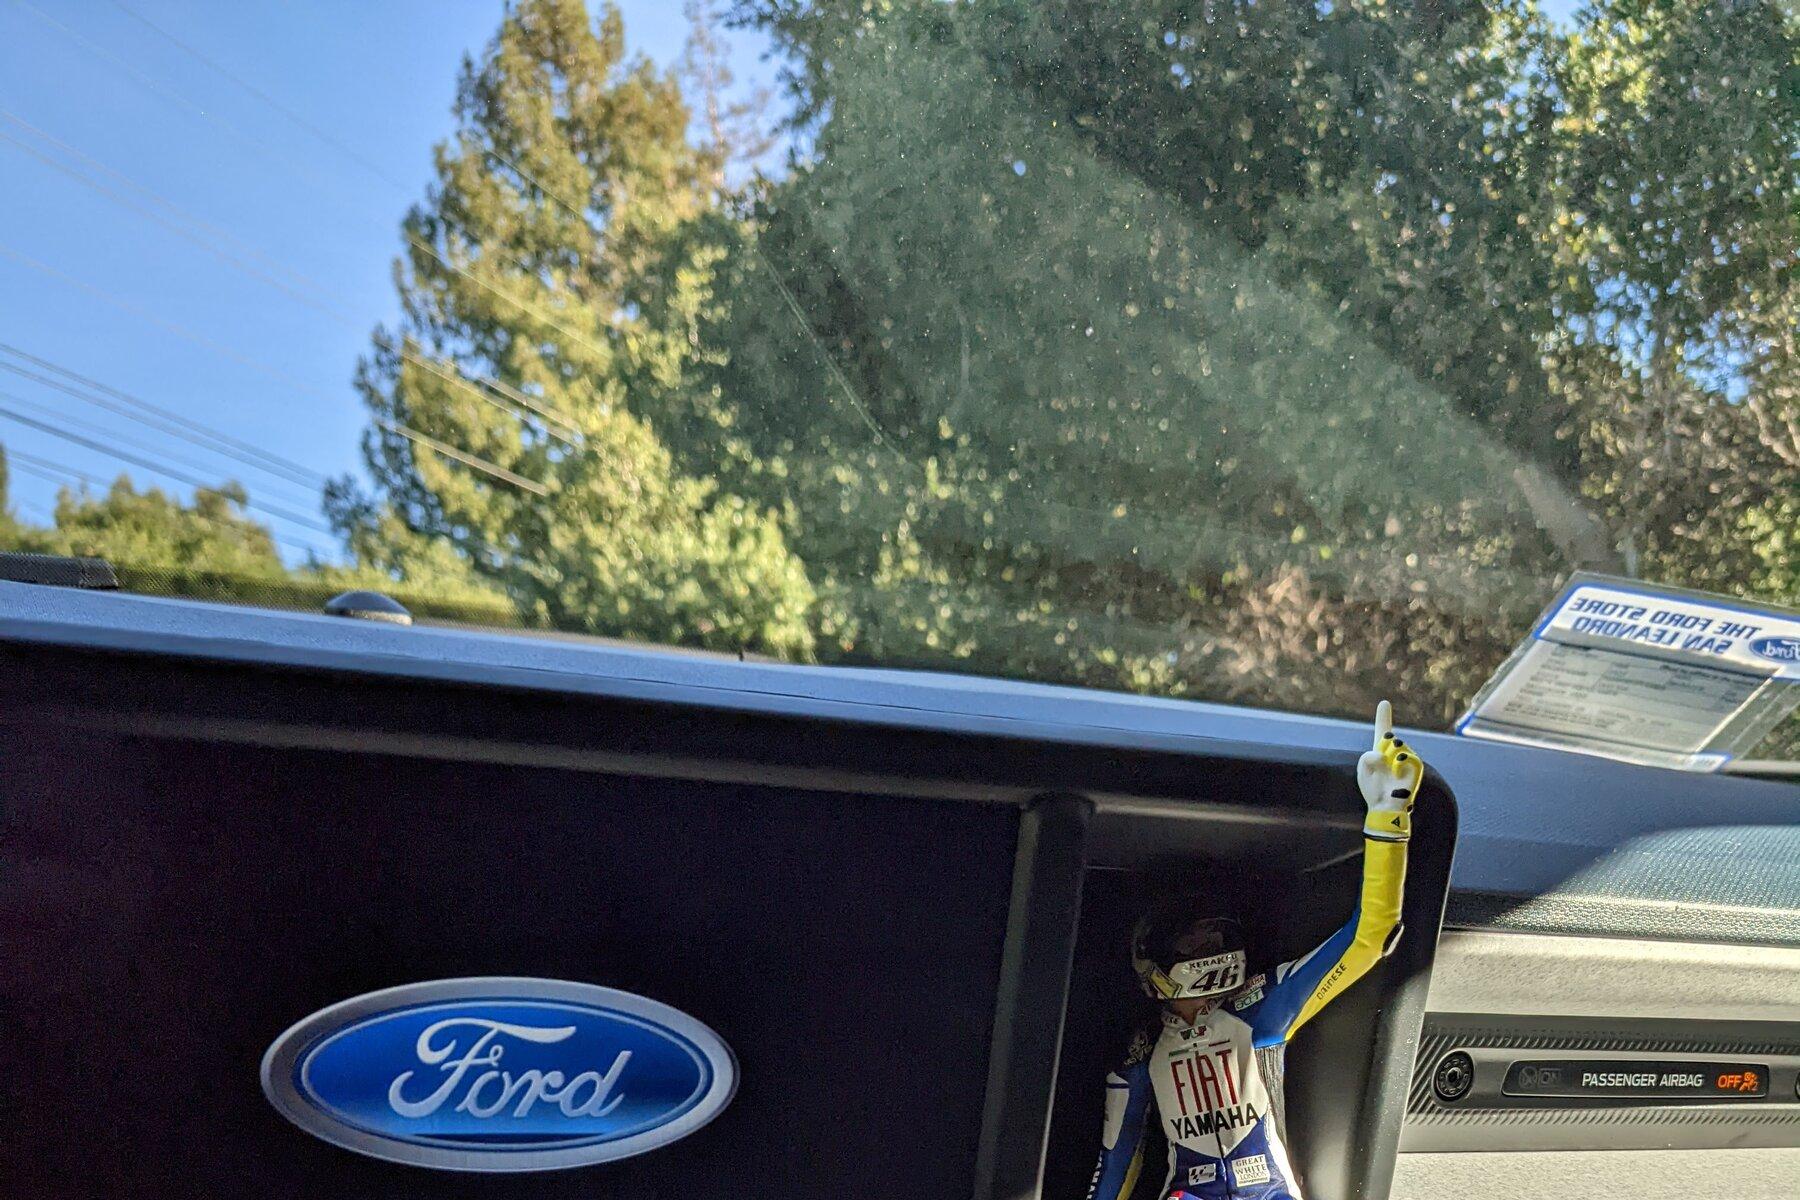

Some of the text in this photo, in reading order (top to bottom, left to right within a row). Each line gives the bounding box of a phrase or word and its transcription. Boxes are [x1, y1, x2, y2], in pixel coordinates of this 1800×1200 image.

[1188, 963, 1240, 992] 46
[388, 1016, 633, 1119] Ford
[1170, 1049, 1238, 1117] FIAT
[1581, 1072, 1704, 1087] PASSENGER AIRBAG
[1717, 1074, 1742, 1088] OFF
[1170, 1102, 1261, 1140] YAMAHA
[1235, 1156, 1264, 1167] GREAT
[1236, 1164, 1267, 1175] WHITE
